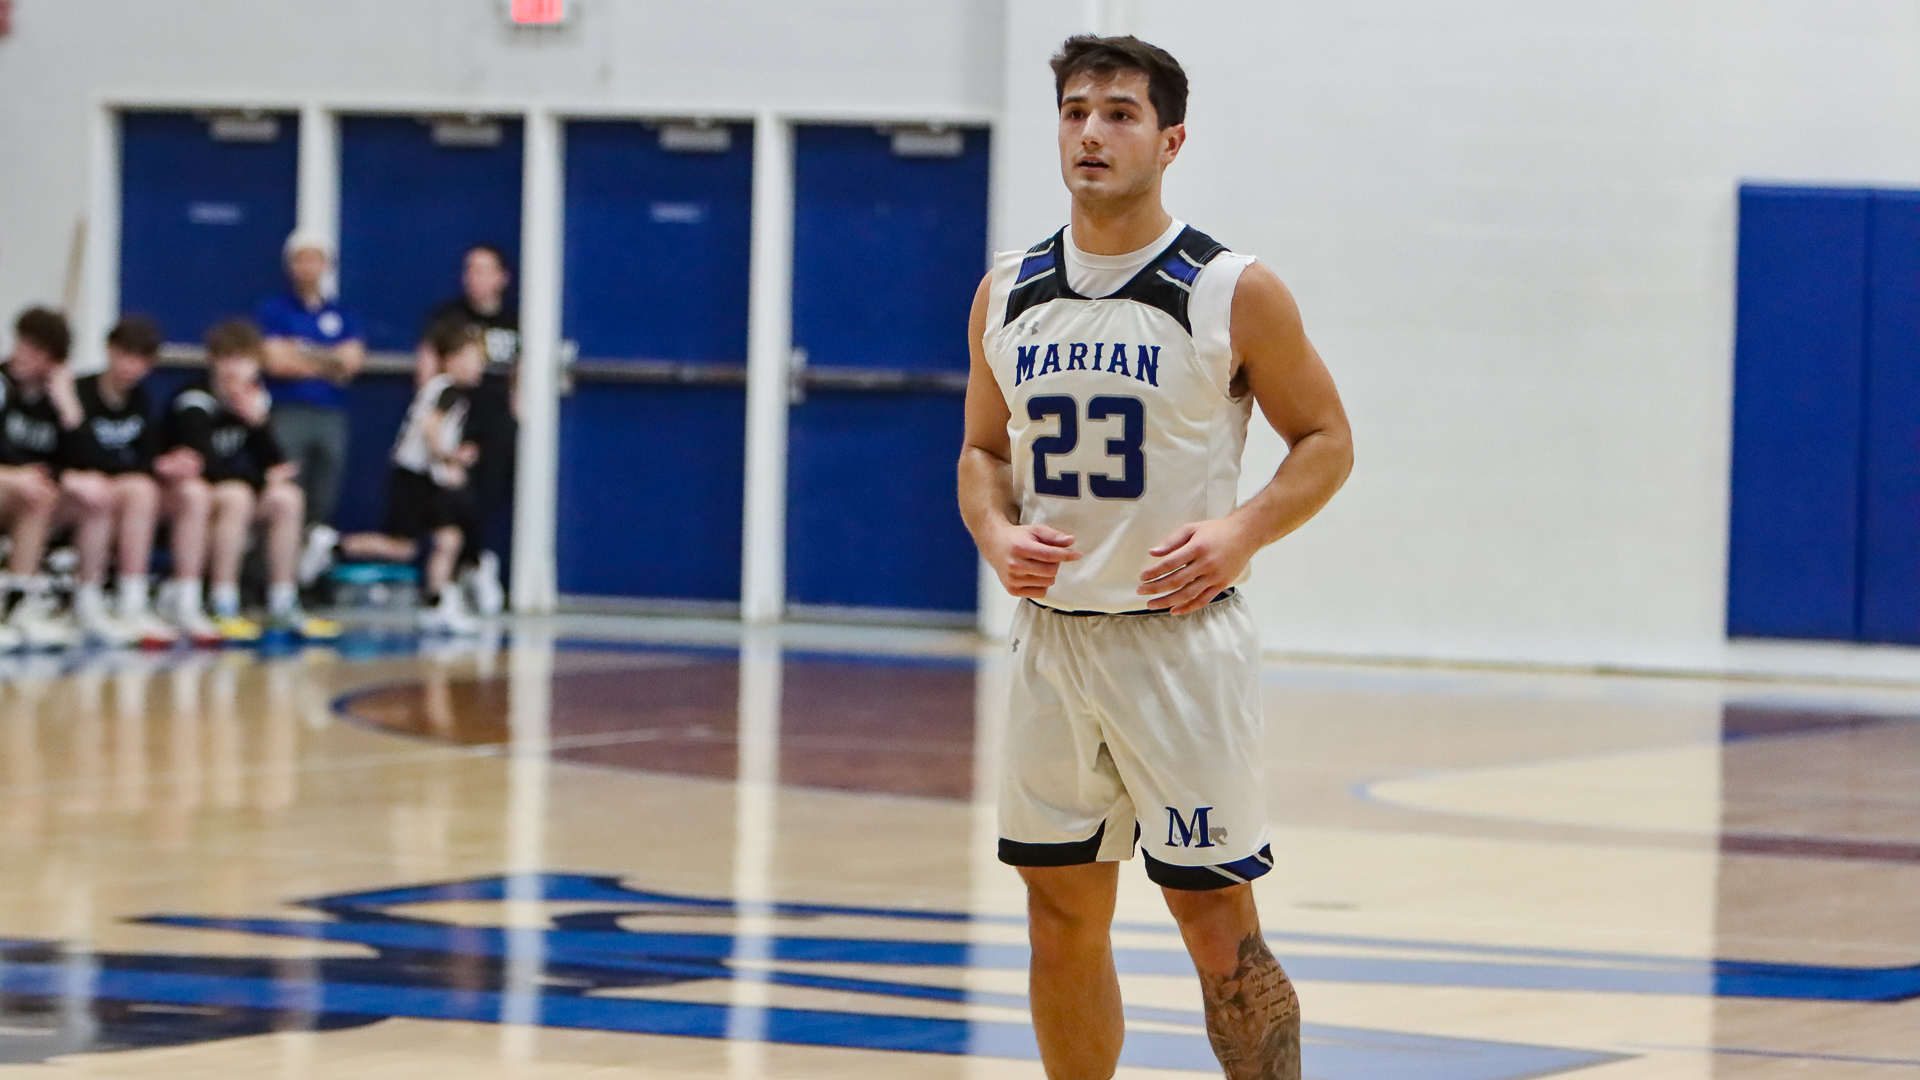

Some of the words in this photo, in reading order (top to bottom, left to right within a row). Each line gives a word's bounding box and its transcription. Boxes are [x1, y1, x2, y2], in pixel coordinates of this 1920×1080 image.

[1015, 343, 1161, 387] MARIAN
[1026, 393, 1147, 501] 23
[1165, 806, 1215, 848] M
